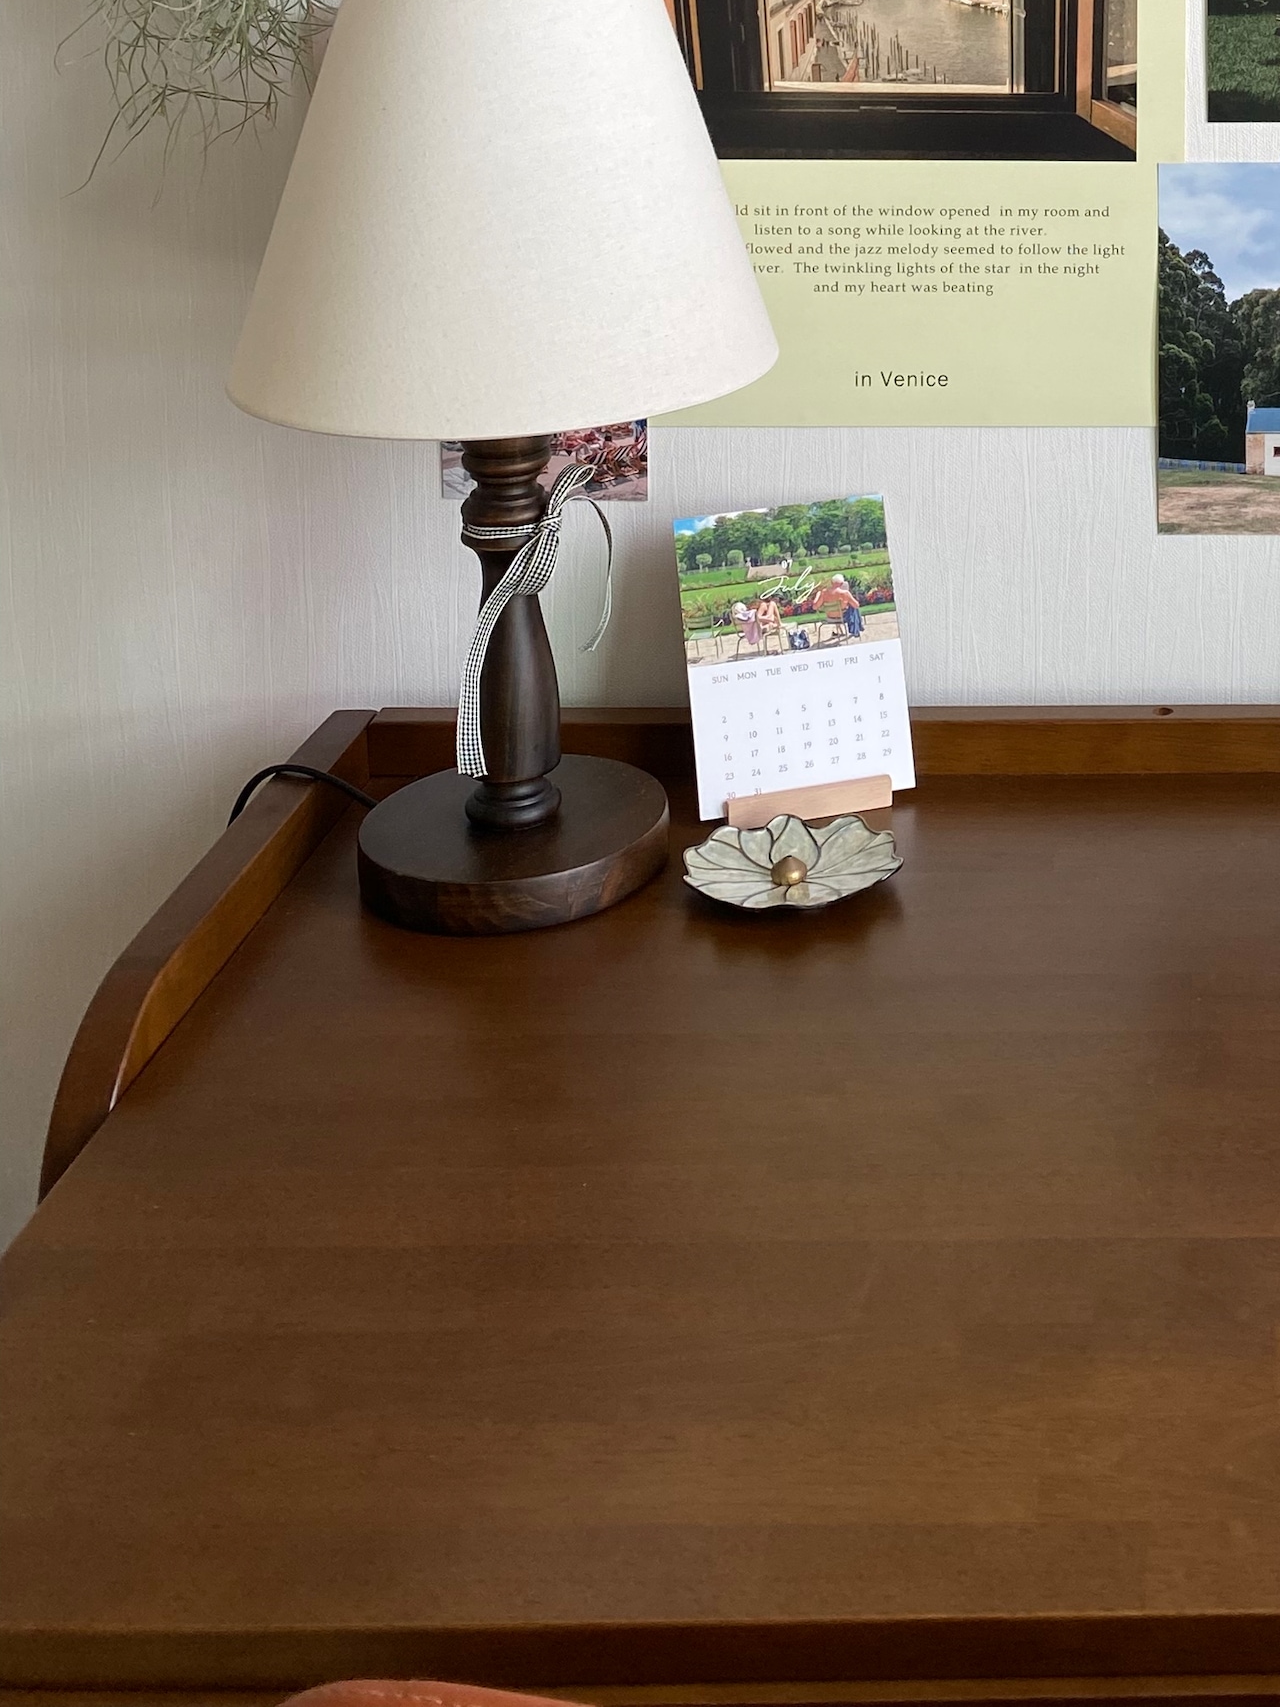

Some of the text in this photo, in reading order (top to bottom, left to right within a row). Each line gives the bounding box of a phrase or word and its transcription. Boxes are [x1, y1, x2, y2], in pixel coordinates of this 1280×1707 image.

[753, 205, 771, 217] sit
[775, 204, 790, 217] in
[793, 204, 829, 217] front
[833, 204, 848, 217] of
[852, 204, 874, 217] the
[878, 204, 935, 217] window
[939, 204, 990, 221] opened
[999, 205, 1013, 217] in
[1017, 208, 1039, 221] my
[1043, 208, 1080, 217] room
[1084, 205, 1110, 218] and
[754, 223, 1047, 240] listen to a song while looking at the river.
[797, 242, 824, 255] and
[828, 242, 851, 255] the
[854, 243, 883, 259] jazz
[887, 242, 939, 259] melody
[943, 243, 995, 255] seemed
[1000, 244, 1014, 255] to
[1018, 242, 1062, 256] follow
[1067, 243, 1089, 256] the
[1093, 243, 1126, 259] light
[752, 261, 1100, 278] iver. The twinkling lights of the star in the night
[813, 280, 994, 297] and my heart was beating
[855, 370, 949, 388] in Venice
[781, 559, 793, 569] 07
[758, 565, 821, 604] July
[712, 653, 885, 684] SUN MON TUE WED THU FRI SAT
[749, 730, 757, 738] 10
[776, 727, 783, 735] 11
[802, 723, 810, 731] 12
[828, 719, 836, 727] 13
[853, 715, 862, 723] 14
[879, 711, 888, 719] 15
[724, 729, 890, 762] 16 17 18 19 20 21 22
[725, 748, 892, 781] 23 24 25 26 27 28 29
[727, 787, 762, 800] 30 31
